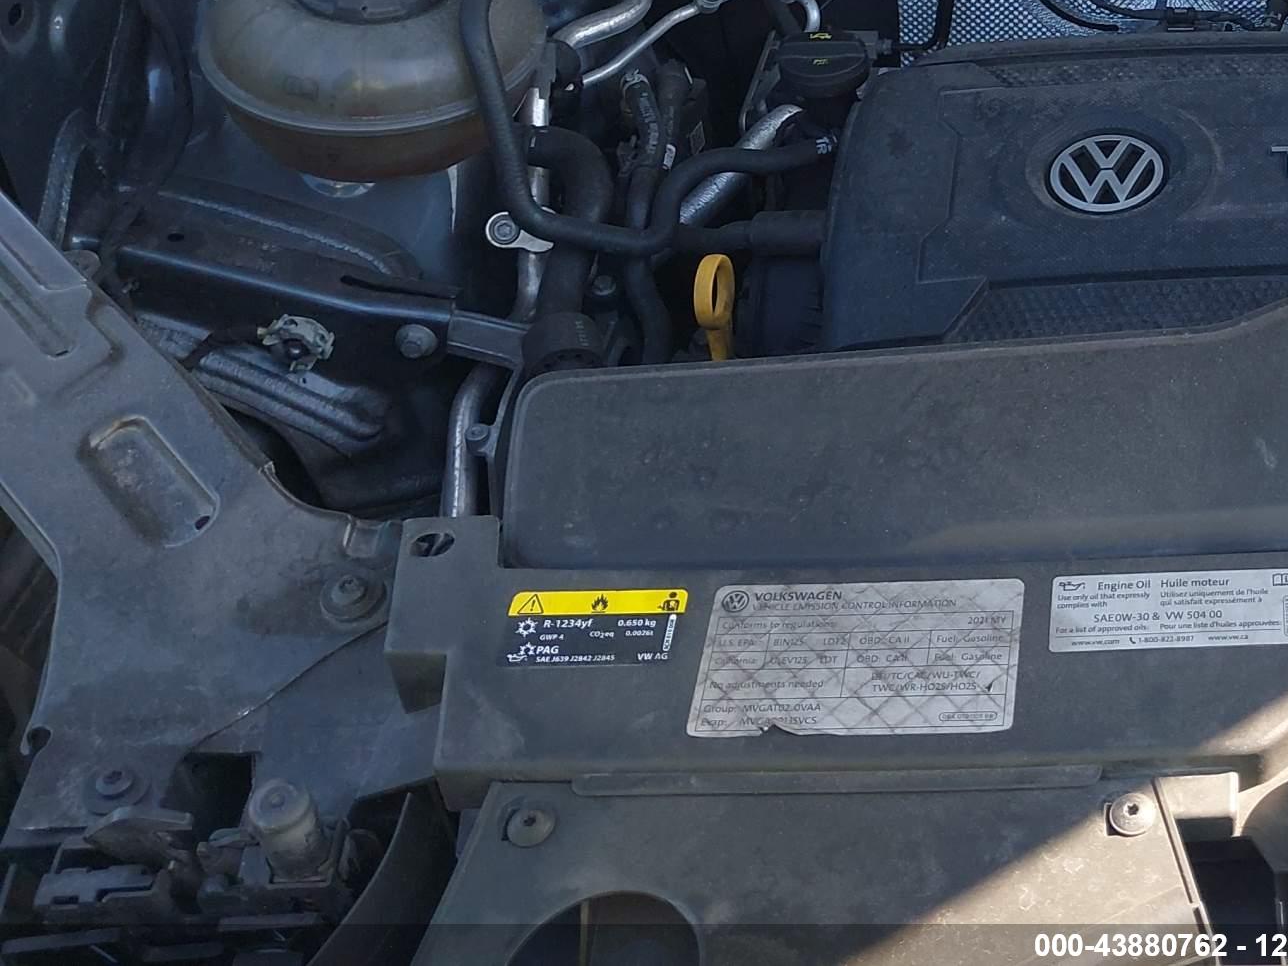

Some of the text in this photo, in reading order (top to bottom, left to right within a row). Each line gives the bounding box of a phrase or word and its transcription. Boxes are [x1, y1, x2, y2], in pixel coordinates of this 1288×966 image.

[1097, 577, 1230, 593] Engine Oil Huile moteur
[754, 591, 842, 602] VOLKSWAGEN
[1072, 594, 1088, 603] only
[1100, 592, 1115, 600] that
[1116, 591, 1150, 601] expressly
[1160, 590, 1188, 599] Utilisez
[1189, 589, 1234, 599] uniquement
[1235, 588, 1245, 596] de
[752, 598, 957, 611] VEHICLE EMISSION CONTROL INFORMATION
[1160, 599, 1172, 607] qui
[1173, 597, 1203, 606] satisfait
[1204, 595, 1255, 606] expressément
[1094, 609, 1223, 624] SAE0W-30 & VW 504 00
[543, 618, 657, 630] R-1234yf 0.650 kg
[770, 621, 780, 629] to
[1055, 626, 1067, 634] For
[1075, 626, 1087, 634] list
[1088, 625, 1097, 633] of
[1098, 624, 1132, 634] approved
[1160, 622, 1176, 630] Pour
[1177, 622, 1192, 630] une
[1193, 620, 1209, 629] liste
[1209, 619, 1237, 628] d'huiles
[536, 645, 560, 655] PAG
[637, 652, 669, 661] VW AG
[788, 679, 824, 689] needed
